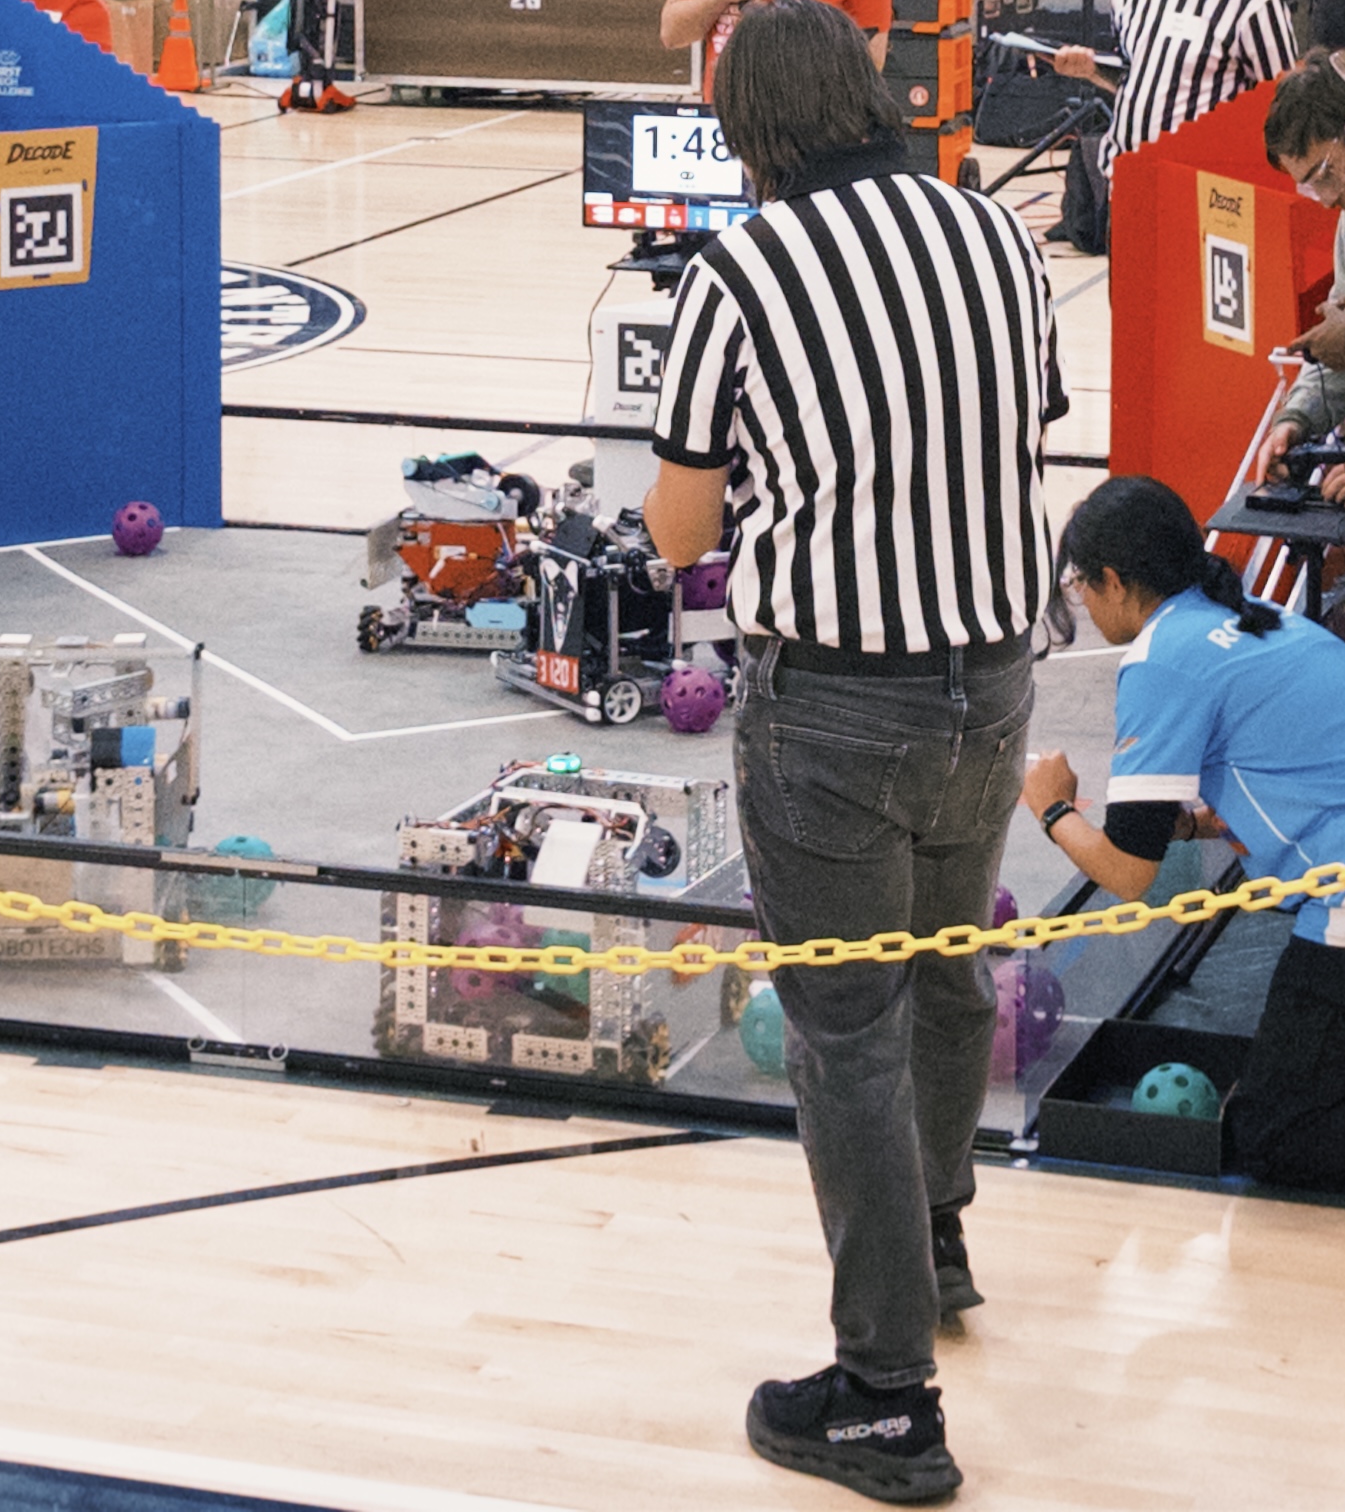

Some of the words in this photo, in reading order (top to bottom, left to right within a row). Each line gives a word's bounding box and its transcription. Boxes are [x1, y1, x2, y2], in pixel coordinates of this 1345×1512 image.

[6, 140, 76, 165] DECODE
[645, 125, 730, 162] 1:48
[827, 1415, 912, 1443] SKECHERS
